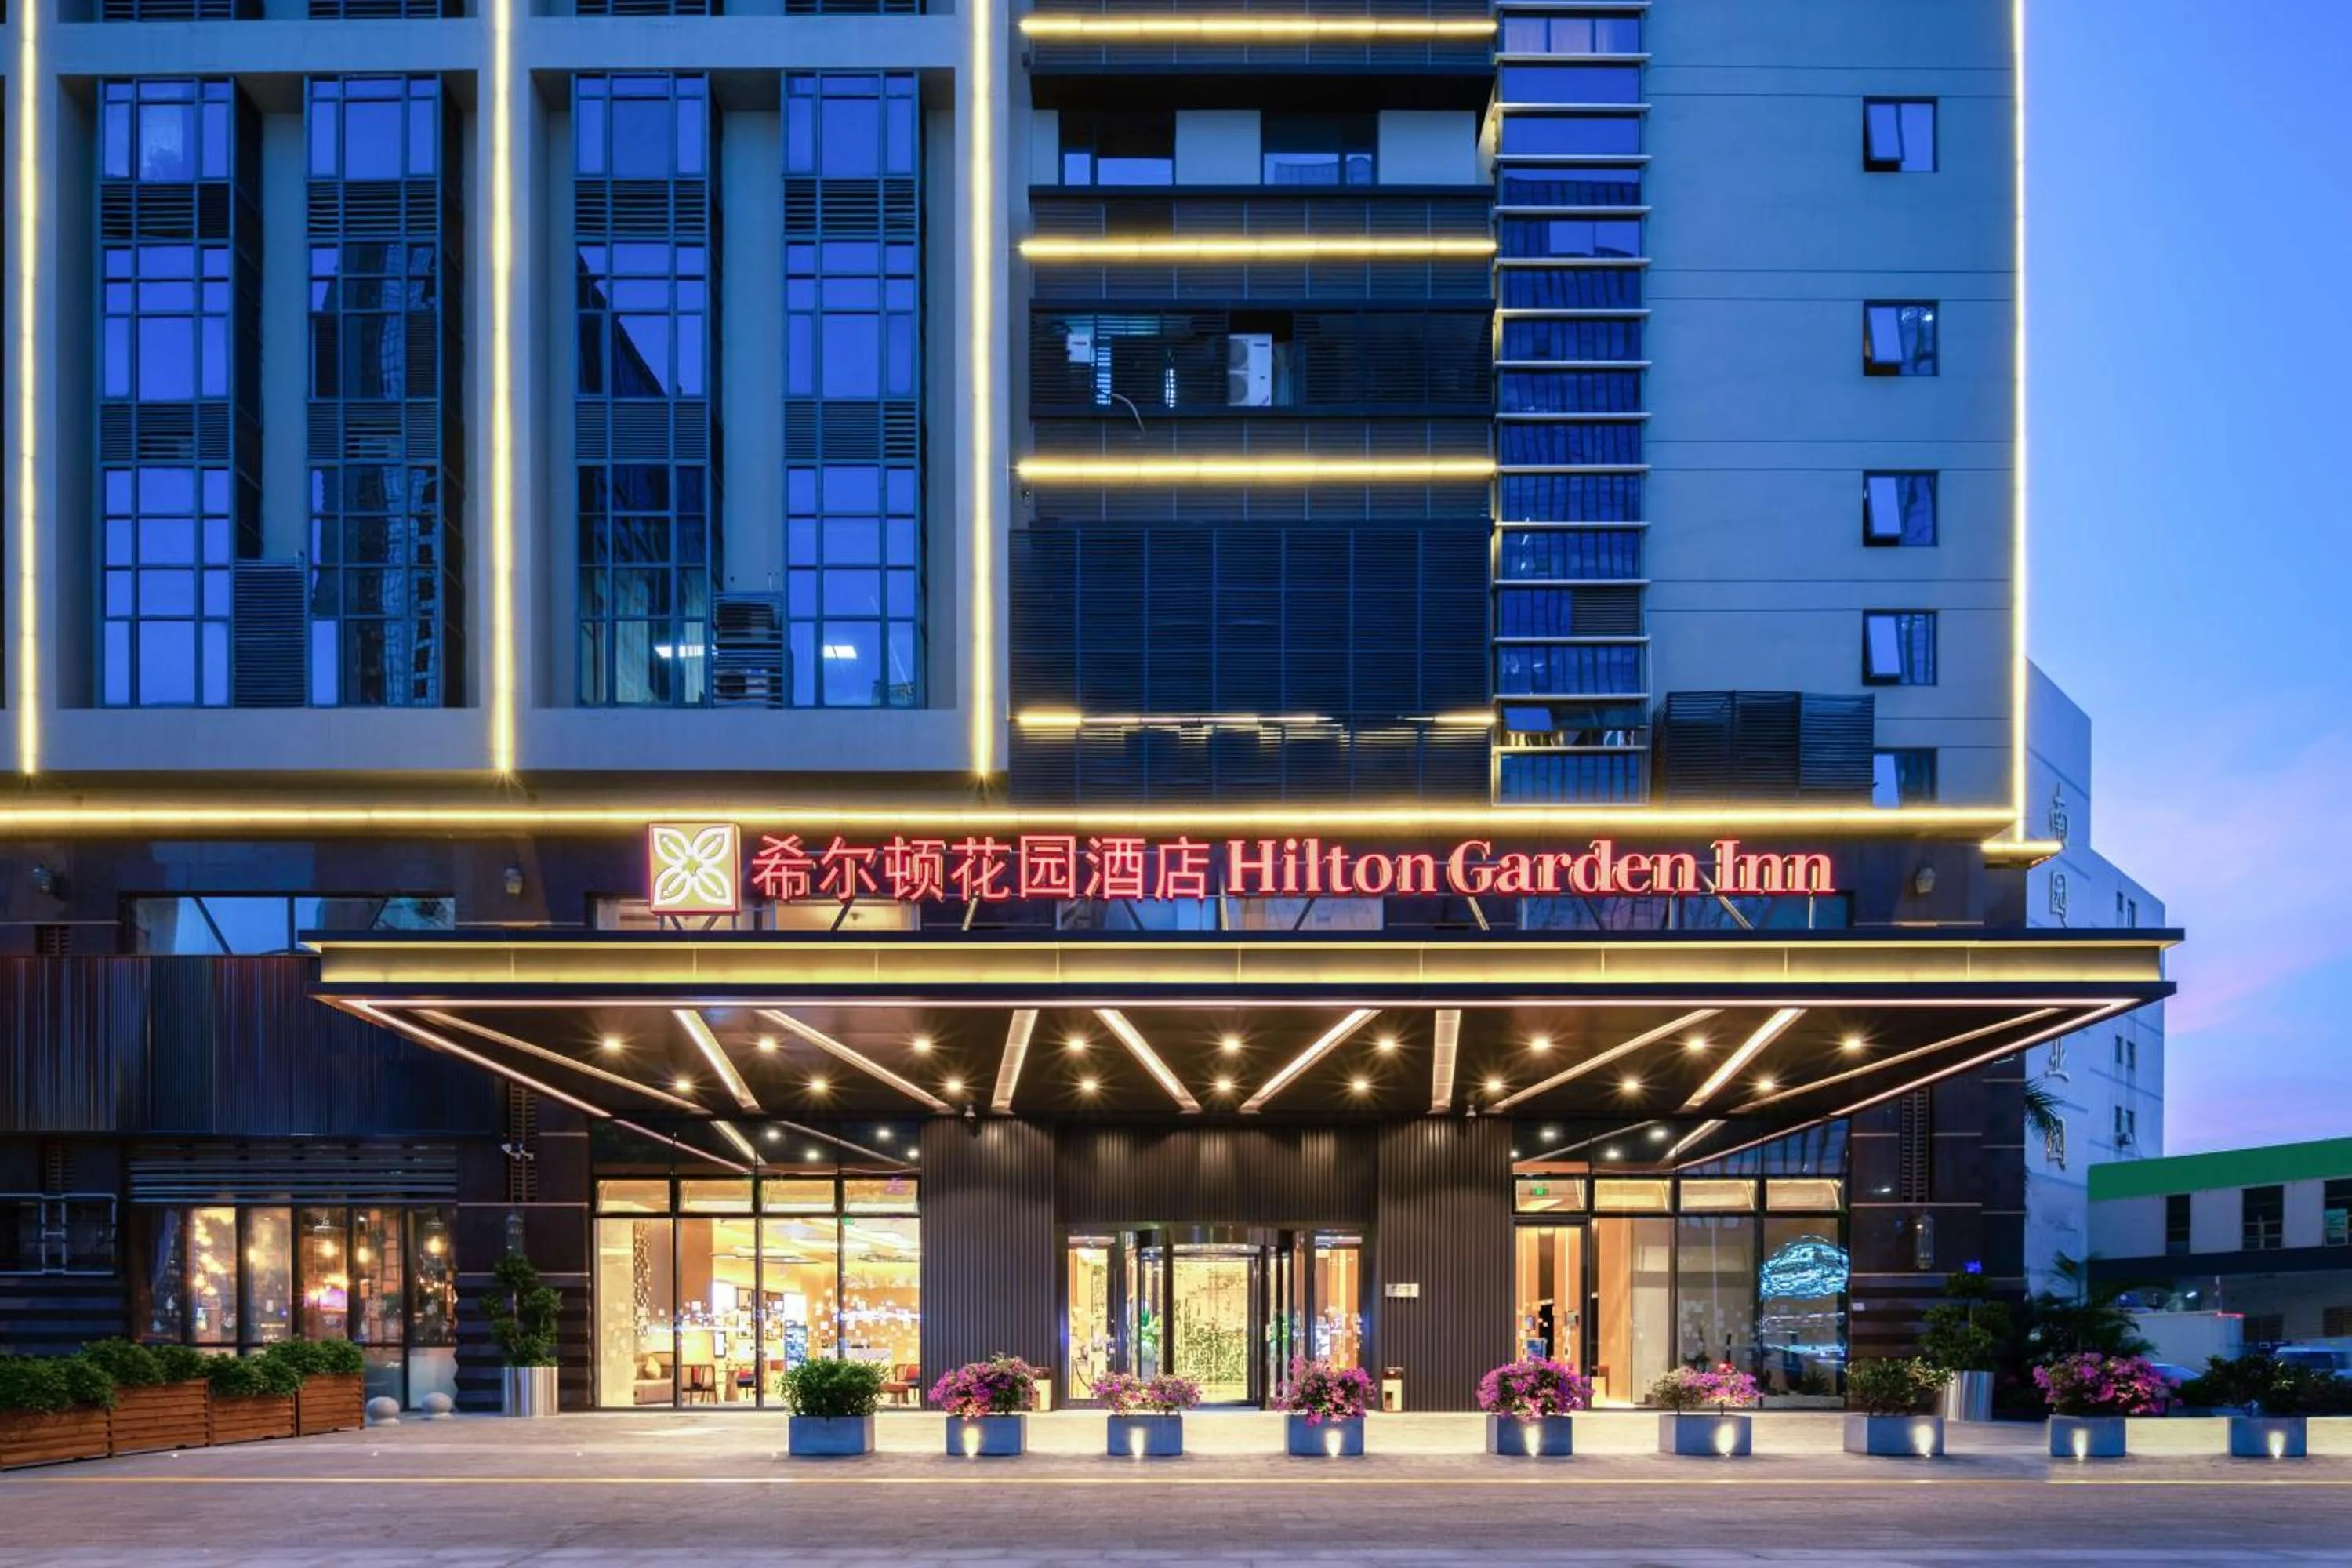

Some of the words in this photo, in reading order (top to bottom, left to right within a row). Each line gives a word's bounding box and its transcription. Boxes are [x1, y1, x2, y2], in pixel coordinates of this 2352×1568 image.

[751, 833, 1210, 902] 希尔顿花园酒店
[1226, 837, 1437, 894] Hilton
[1446, 838, 1700, 894] Garden
[1714, 838, 1836, 895] Inn
